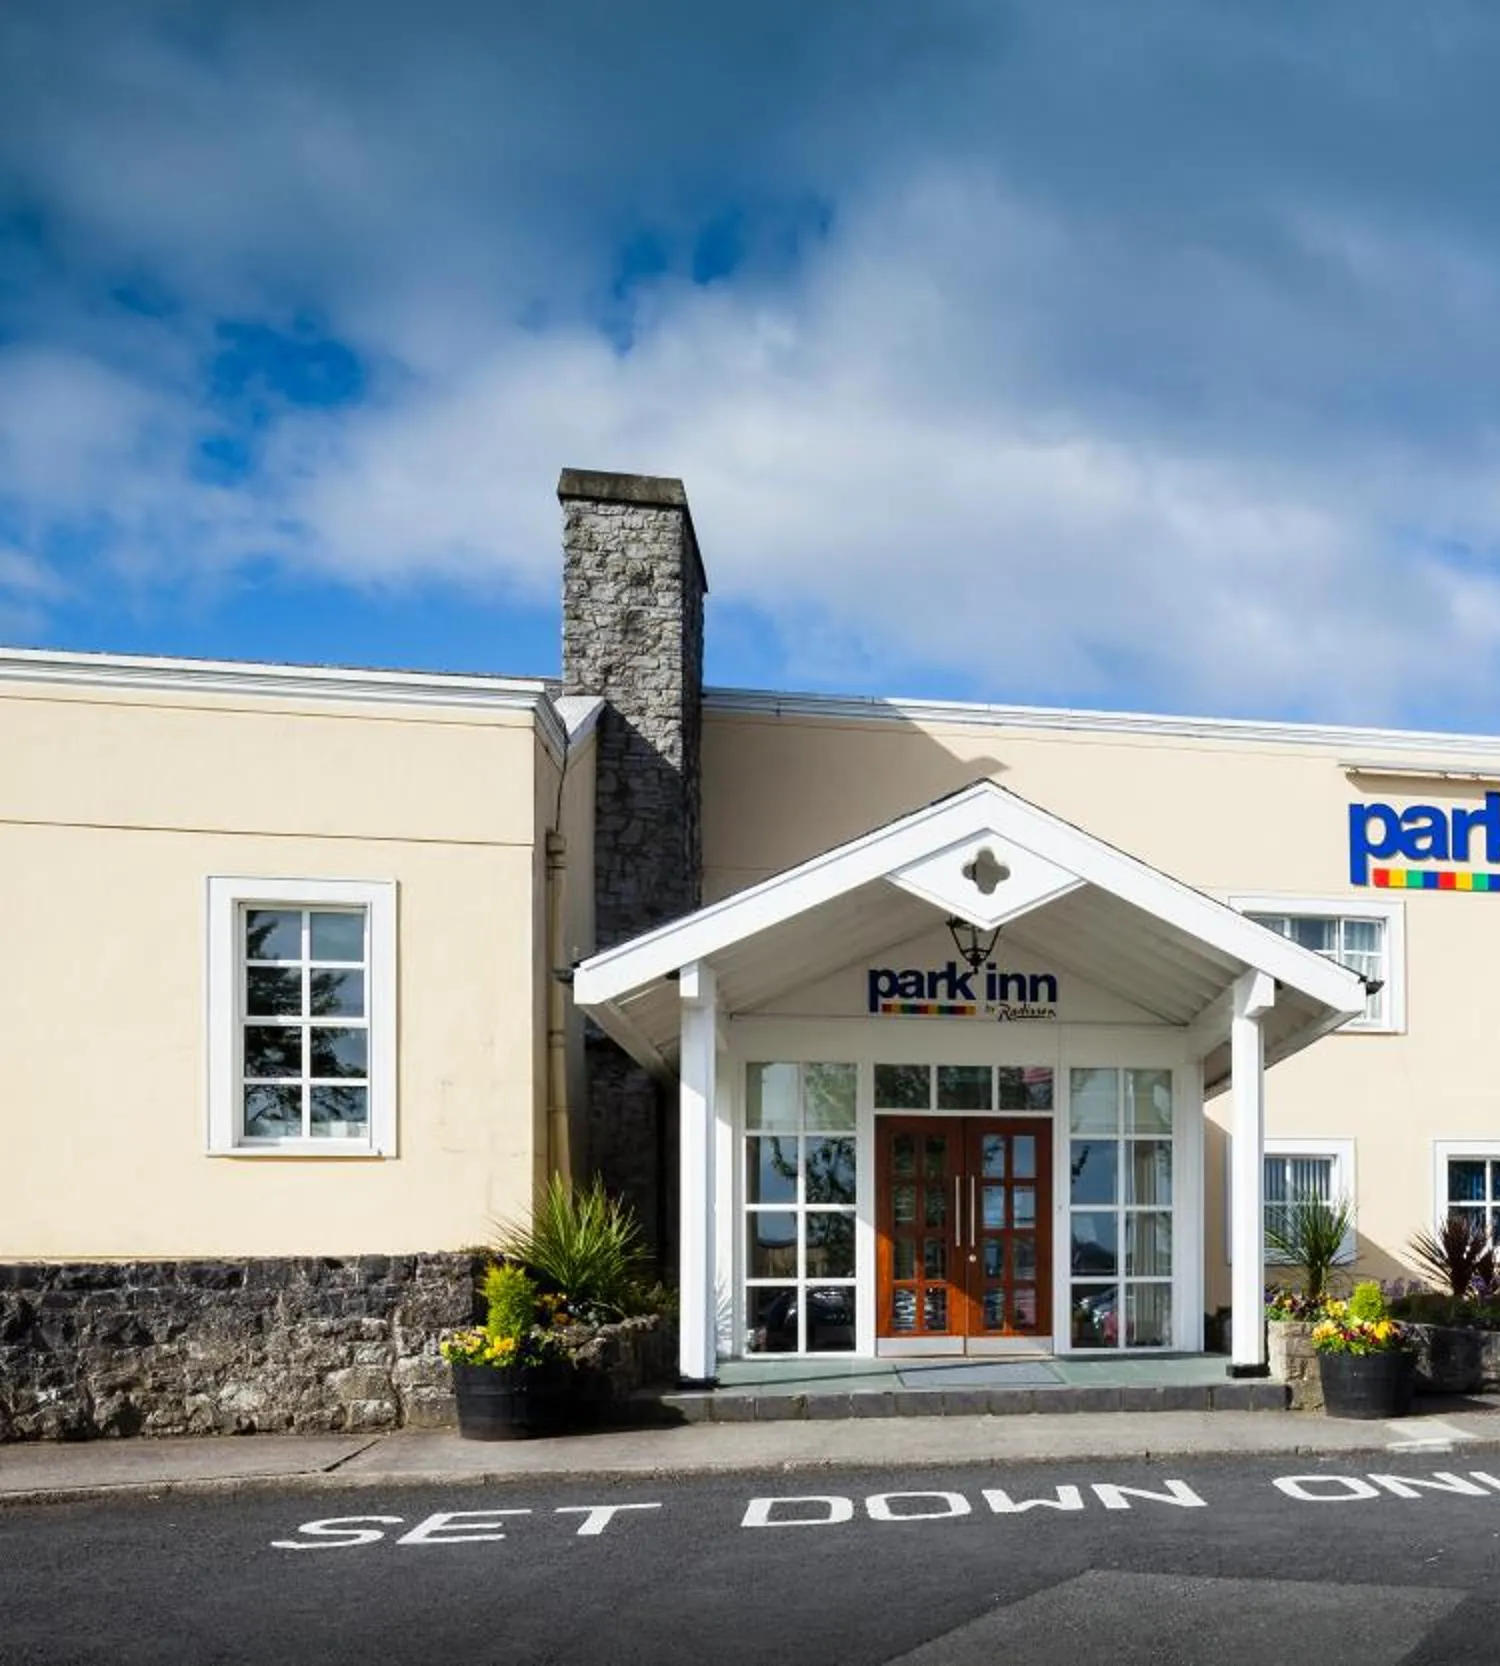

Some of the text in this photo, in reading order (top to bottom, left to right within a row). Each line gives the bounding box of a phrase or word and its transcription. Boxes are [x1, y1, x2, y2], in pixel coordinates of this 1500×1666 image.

[868, 961, 1057, 1013] park inn
[998, 1003, 1057, 1021] Radisson
[271, 1503, 663, 1548] SET
[740, 1479, 1209, 1527] DOWN
